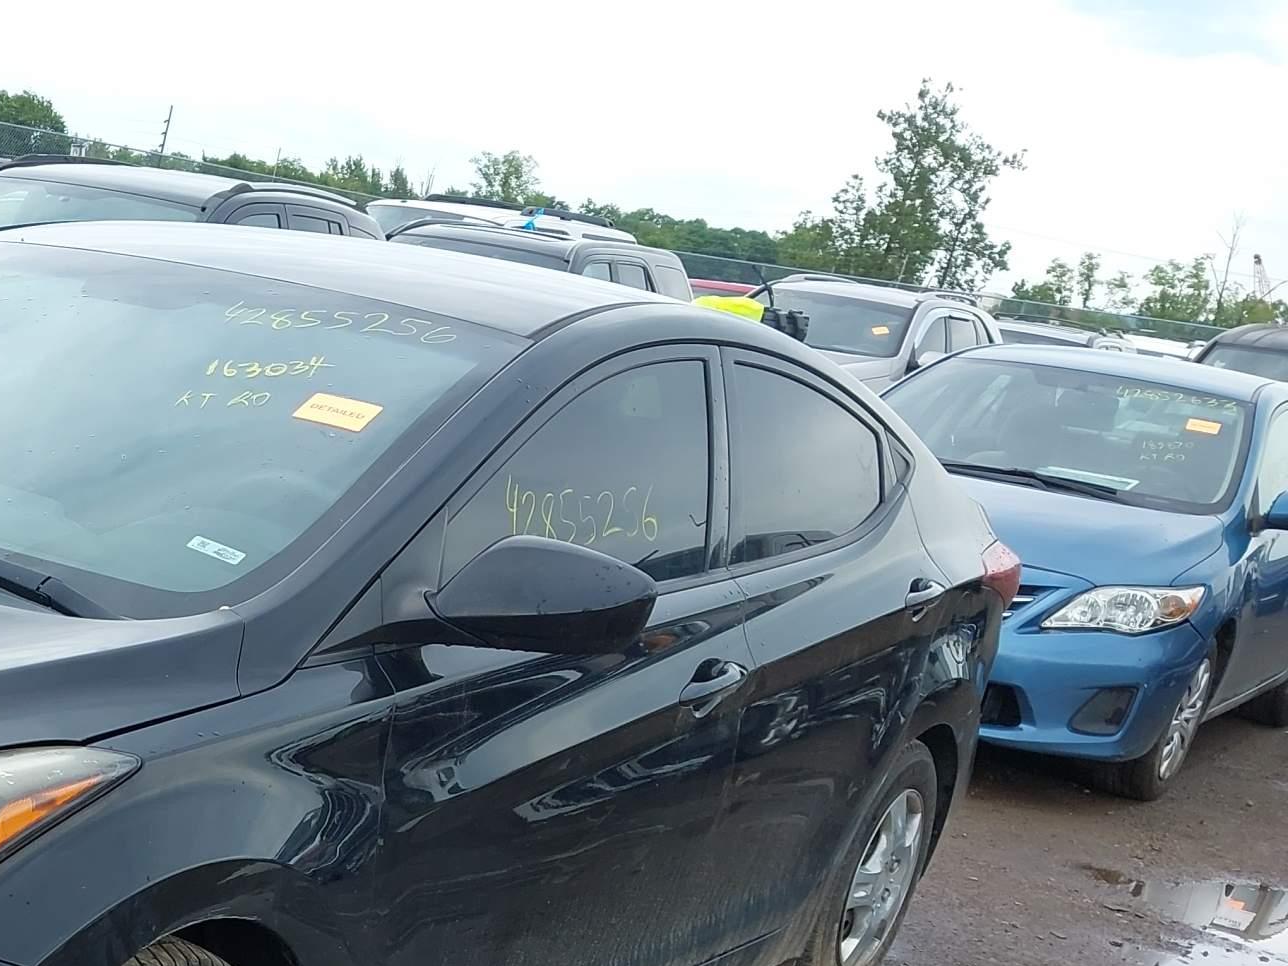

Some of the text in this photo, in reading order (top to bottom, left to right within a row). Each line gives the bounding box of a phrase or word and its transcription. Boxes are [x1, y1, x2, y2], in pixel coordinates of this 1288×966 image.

[224, 301, 457, 344] 42855256
[206, 356, 337, 379] 163034
[505, 474, 659, 545] 42855256
